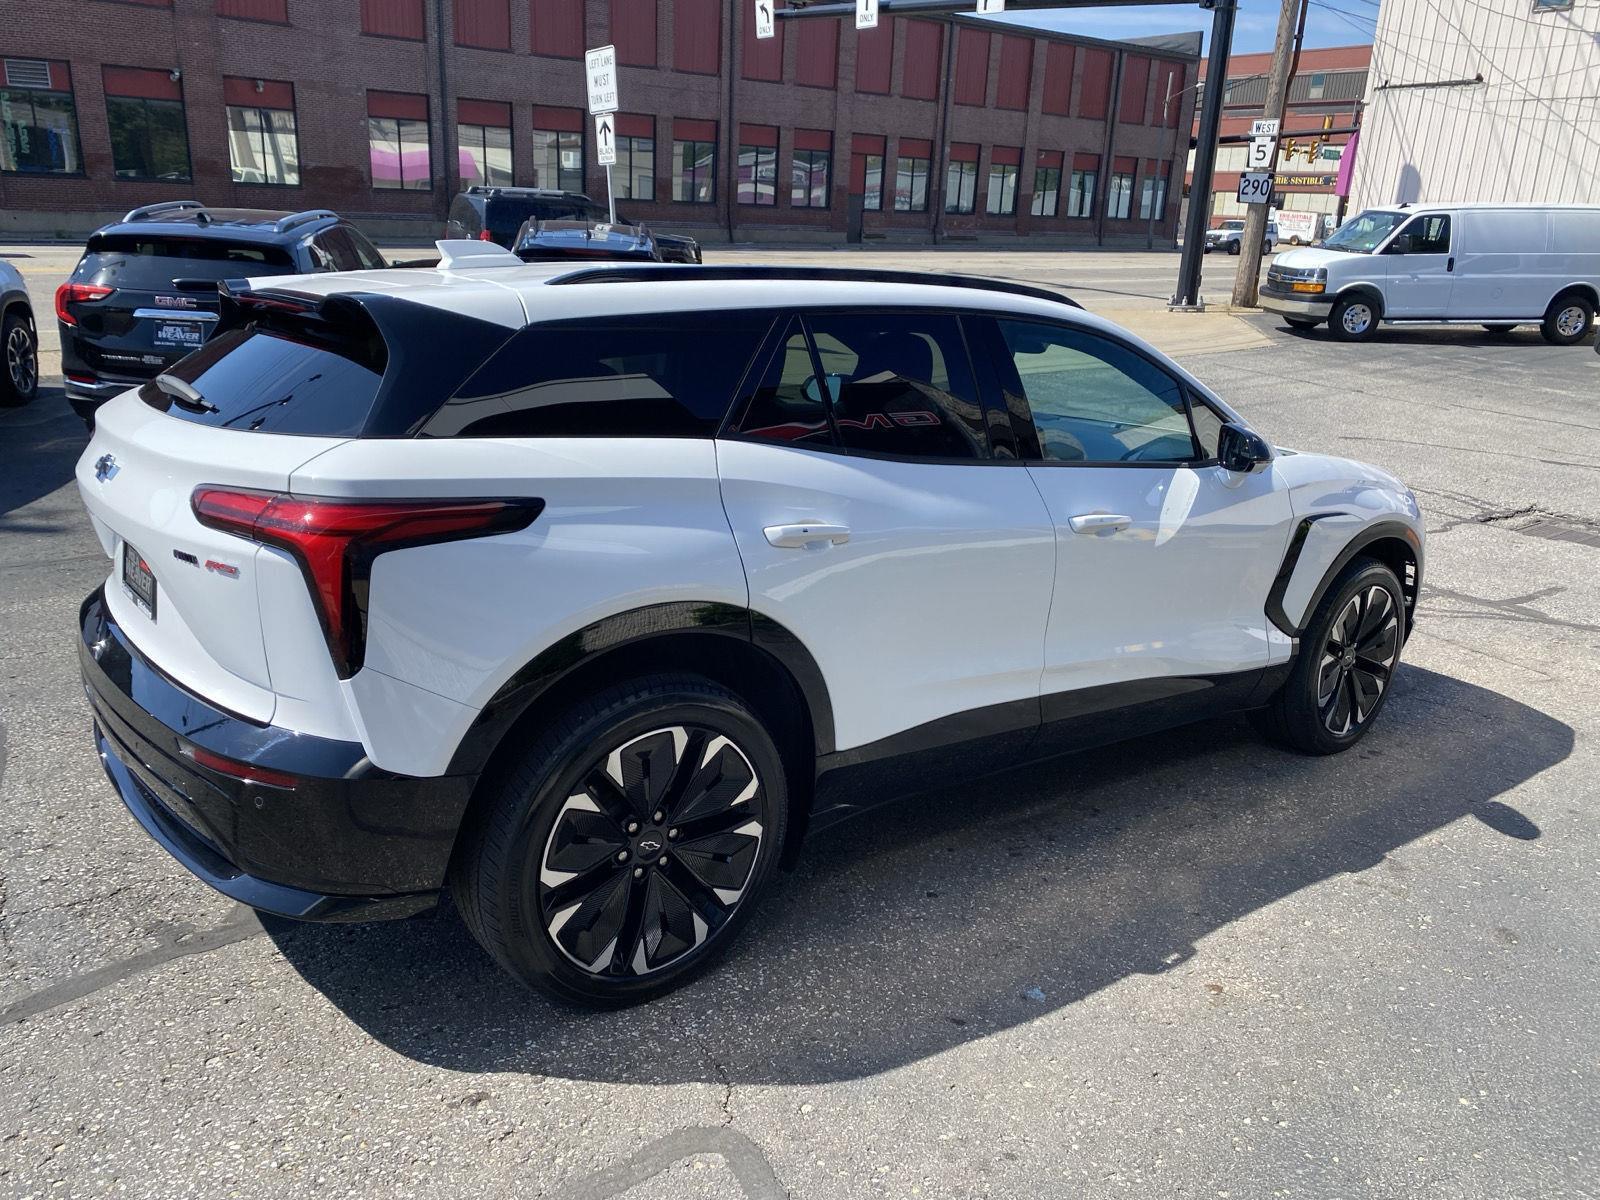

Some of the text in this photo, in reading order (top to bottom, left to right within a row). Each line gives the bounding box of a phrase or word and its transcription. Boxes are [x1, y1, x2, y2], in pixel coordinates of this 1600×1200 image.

[859, 13, 874, 23] ONLY
[758, 25, 772, 35] ONLY
[589, 55, 612, 70] LEFT LANE
[593, 73, 609, 88] MUST
[591, 92, 615, 105] TURN LEFT
[1255, 123, 1276, 133] WEST
[1254, 144, 1267, 161] 5
[1241, 178, 1270, 196] 290
[155, 295, 197, 308] GMC
[157, 330, 200, 340] WEAVER
